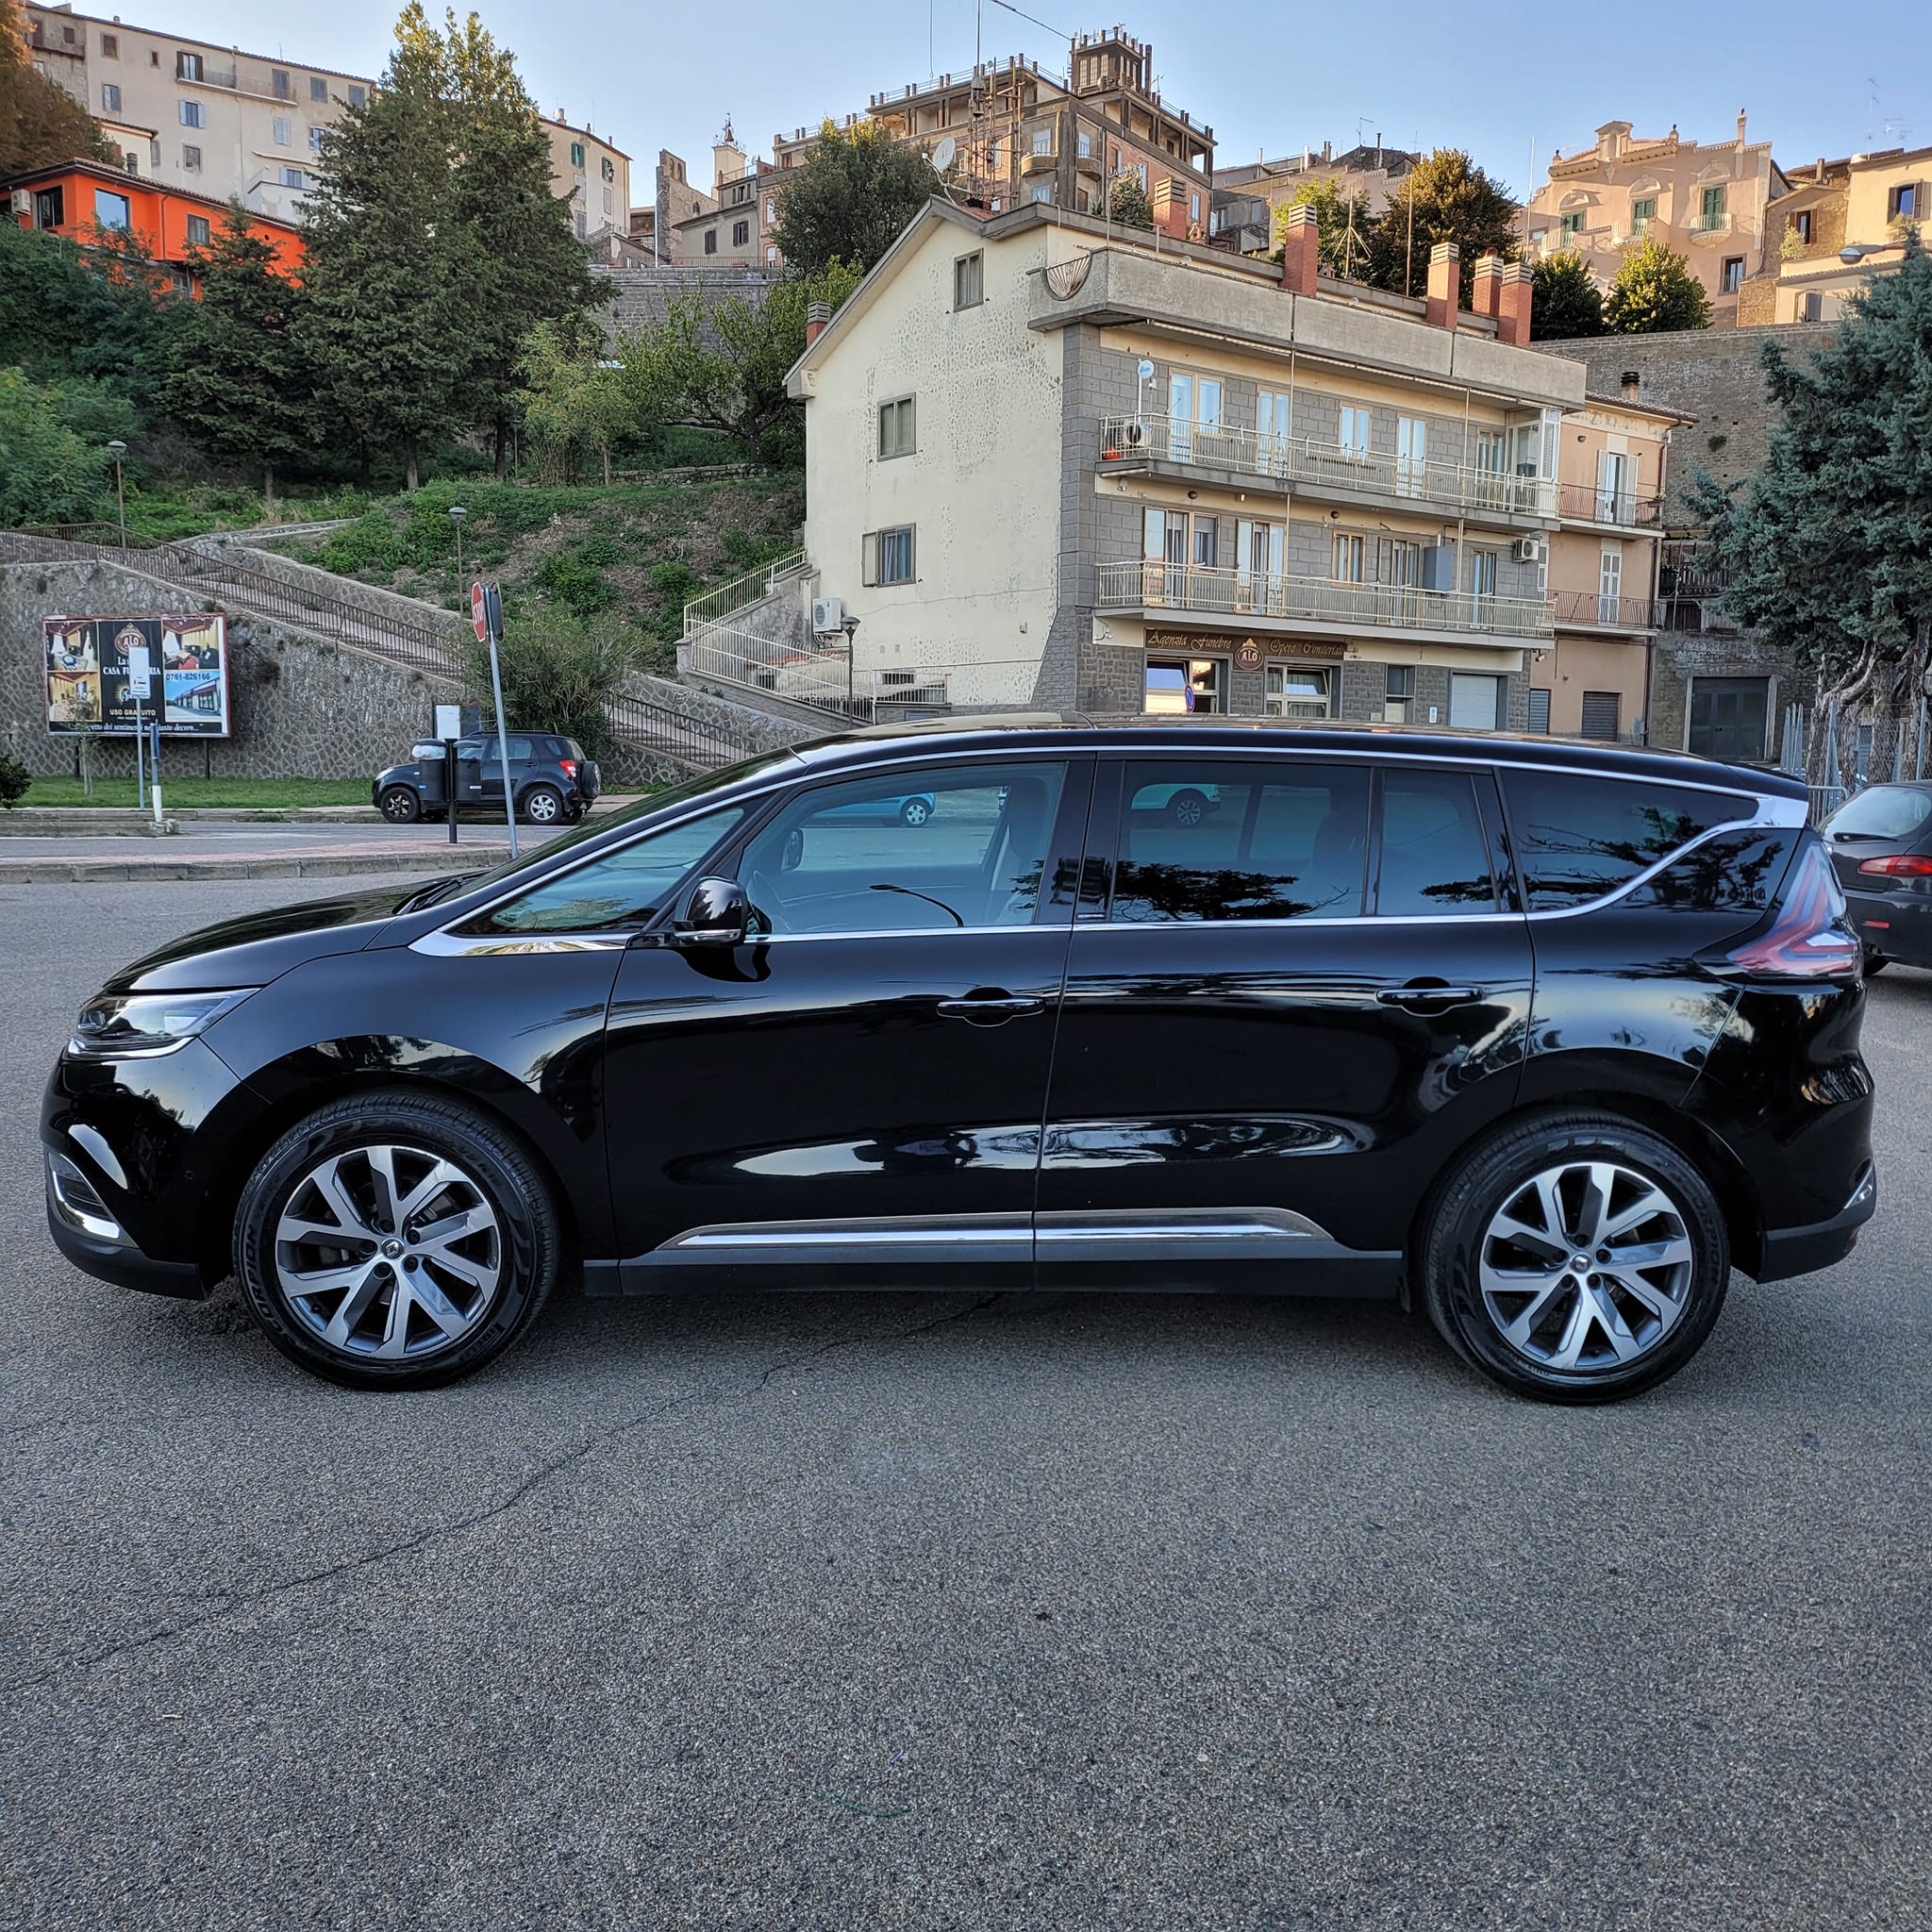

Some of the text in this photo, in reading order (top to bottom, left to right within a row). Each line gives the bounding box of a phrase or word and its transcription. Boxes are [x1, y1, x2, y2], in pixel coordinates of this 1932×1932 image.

[473, 599, 484, 624] STOP
[1147, 631, 1232, 651] Agenzia Funebre
[1269, 639, 1297, 657] Opere
[1241, 651, 1257, 662] ALO
[103, 666, 121, 675] CASA
